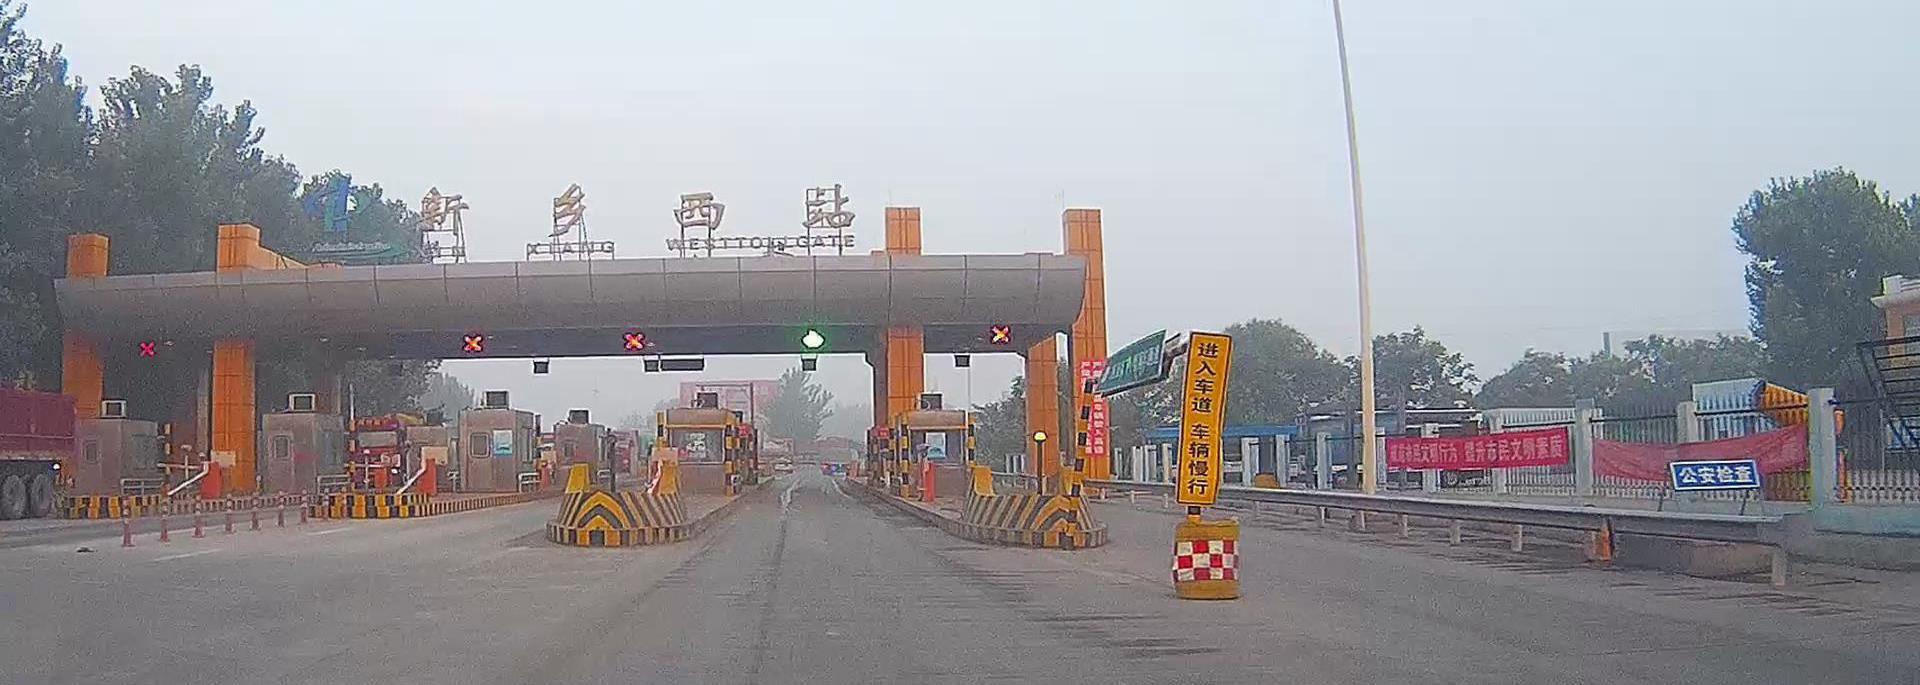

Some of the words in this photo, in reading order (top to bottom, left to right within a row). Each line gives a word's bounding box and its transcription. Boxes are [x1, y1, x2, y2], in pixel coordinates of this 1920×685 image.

[416, 184, 855, 237] 新乡西站
[1192, 342, 1218, 413] 进入车道
[1187, 424, 1210, 496] 车辆慢行
[1679, 466, 1754, 484] 公安检查
